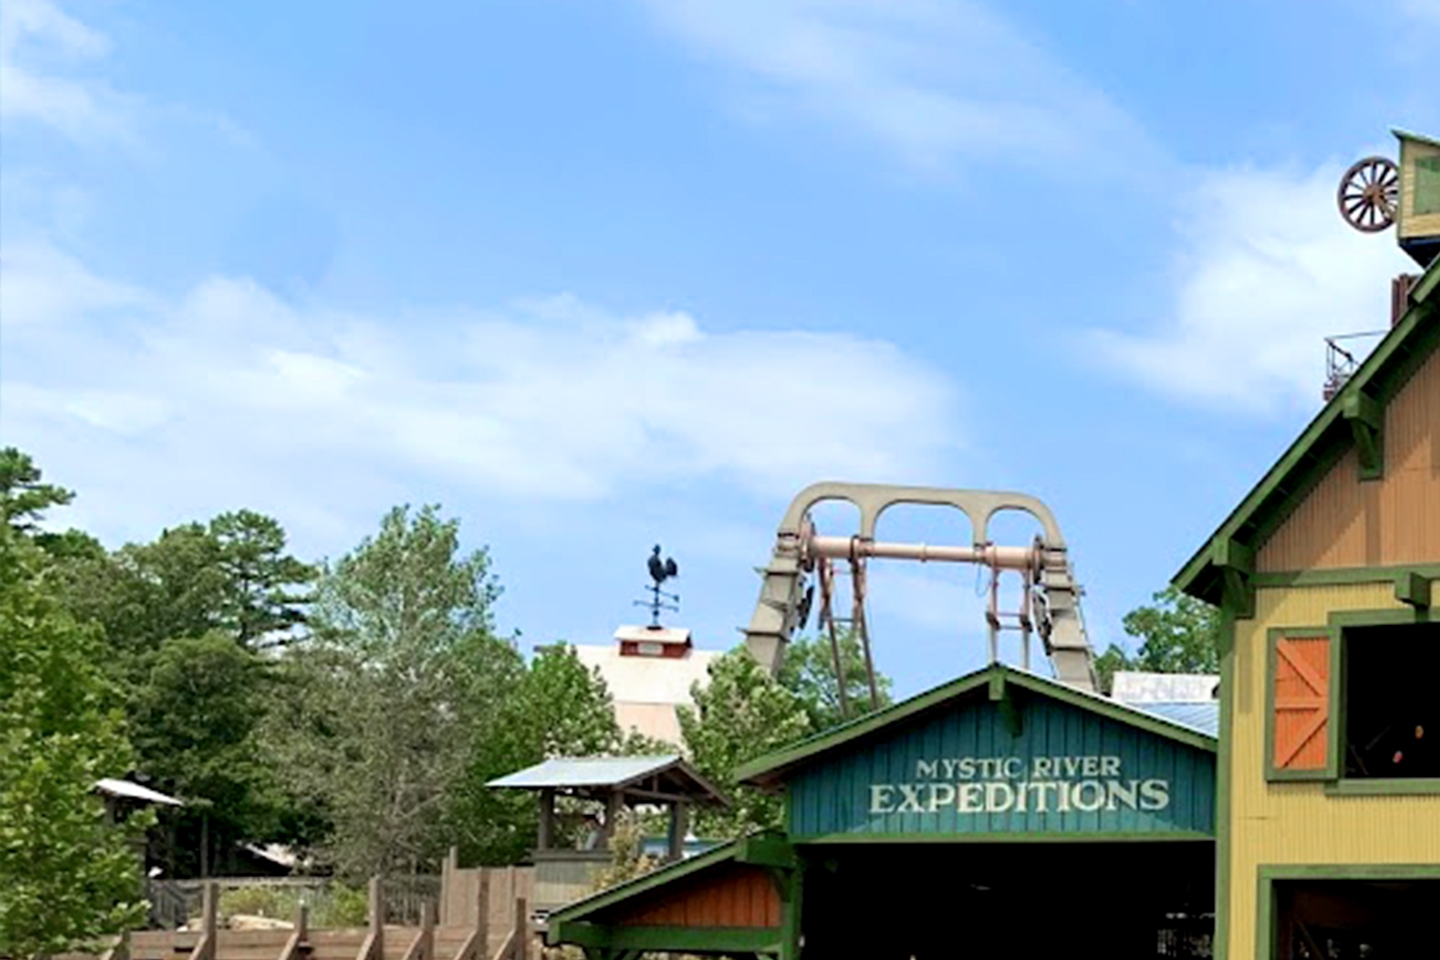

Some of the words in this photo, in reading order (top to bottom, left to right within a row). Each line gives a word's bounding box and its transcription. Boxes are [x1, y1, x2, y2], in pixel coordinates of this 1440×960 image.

[915, 756, 1022, 779] MYSTIC
[1032, 755, 1122, 777] RIVER
[869, 779, 1170, 813] EXPEDITIONS
